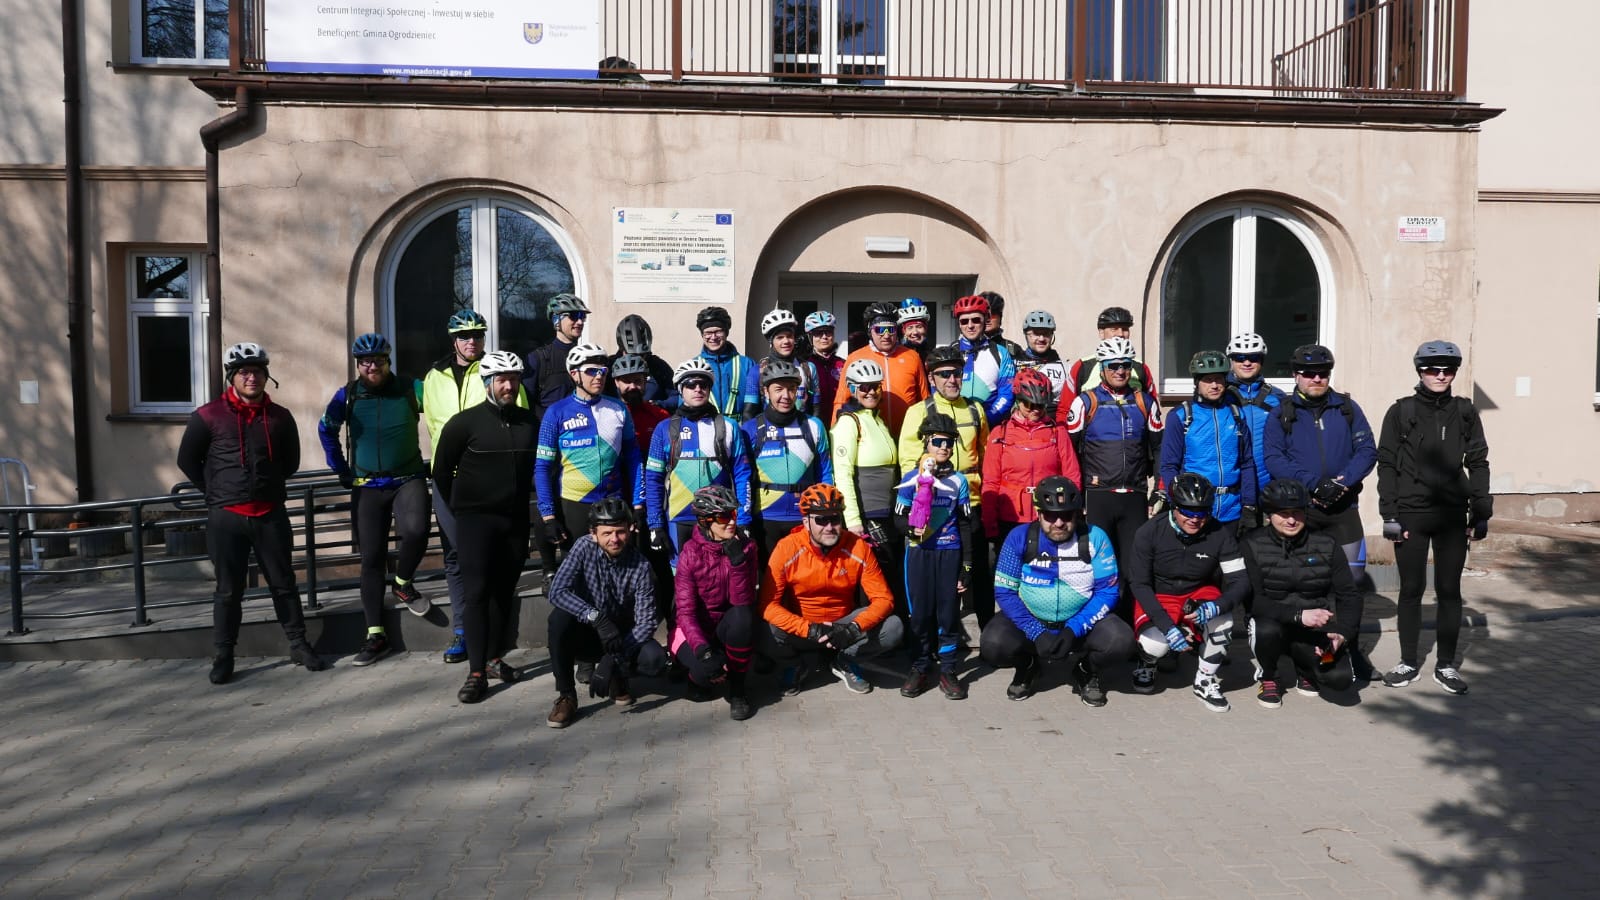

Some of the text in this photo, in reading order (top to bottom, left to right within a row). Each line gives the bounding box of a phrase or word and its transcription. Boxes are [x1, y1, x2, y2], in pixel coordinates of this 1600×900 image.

[317, 6, 348, 14] Centrum
[350, 7, 385, 17] Integracji
[386, 8, 425, 18] Społecznej
[432, 9, 463, 19] Inwestuj
[472, 10, 495, 19] siebie
[317, 28, 436, 40] Beneficjent: Gmina Ogrodzieniec
[382, 68, 472, 77] www.mapadotacji.gov.pl
[1046, 368, 1062, 379] FLY
[571, 439, 592, 447] MAPEI
[1024, 576, 1052, 585] MAPEI
